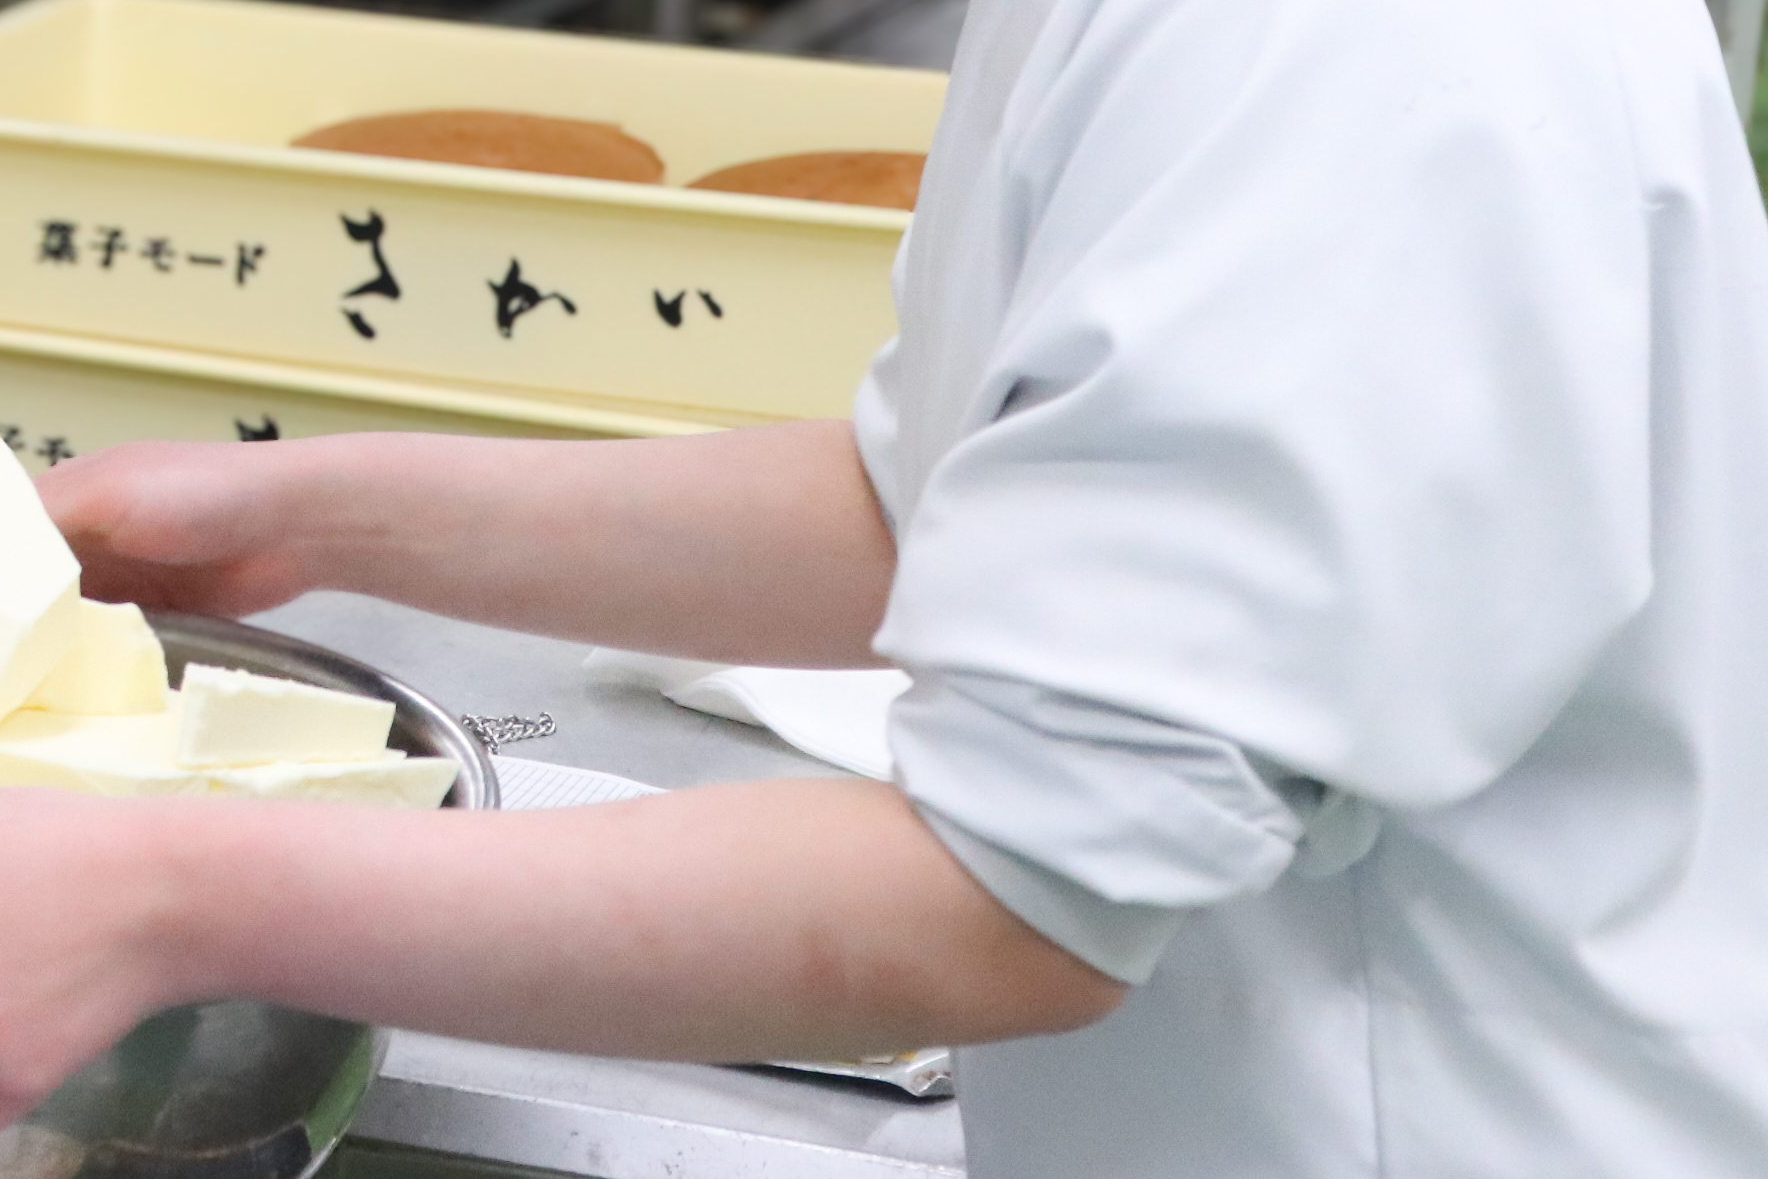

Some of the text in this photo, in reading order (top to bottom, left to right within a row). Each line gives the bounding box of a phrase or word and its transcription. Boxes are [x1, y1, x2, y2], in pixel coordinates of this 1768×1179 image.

[35, 219, 265, 287] 菓子モード
